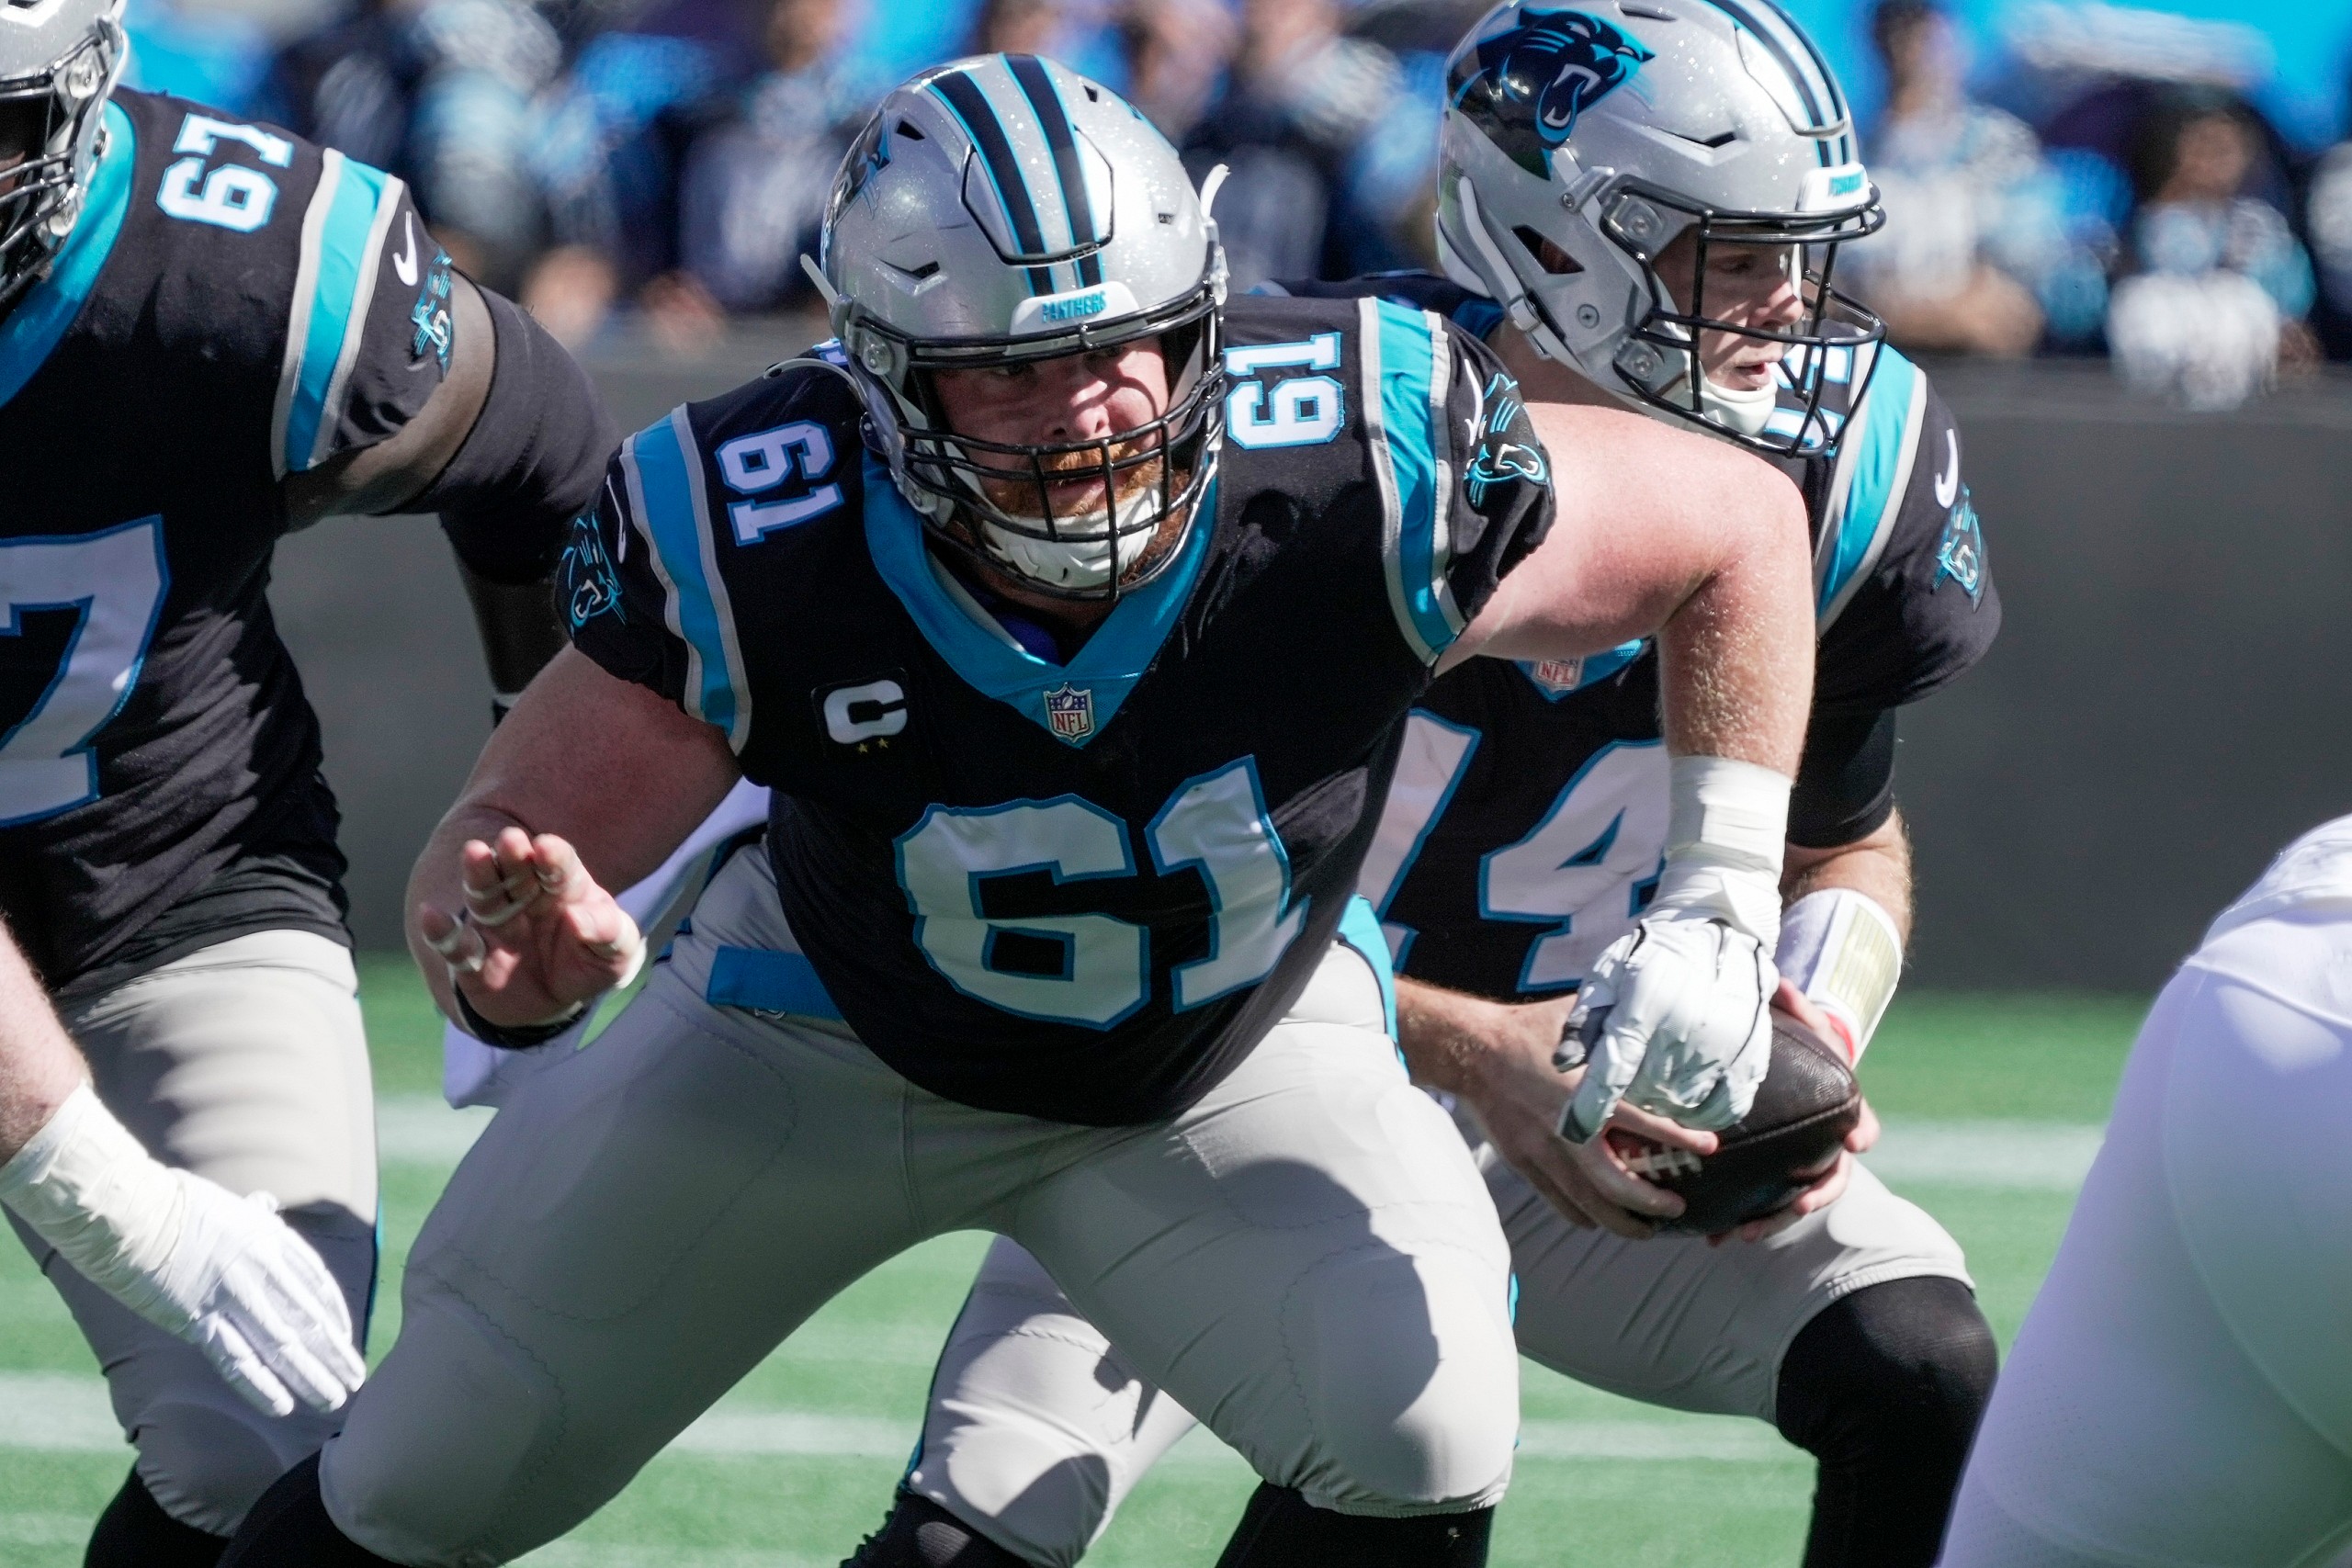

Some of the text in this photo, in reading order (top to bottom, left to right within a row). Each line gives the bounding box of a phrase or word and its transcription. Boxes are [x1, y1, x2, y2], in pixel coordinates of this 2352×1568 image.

[156, 112, 293, 233] 67
[1041, 291, 1106, 323] PANTHERS
[1224, 332, 1345, 450] 61
[715, 420, 843, 547] 61
[823, 680, 908, 744] C
[1054, 712, 1087, 733] NFL
[894, 754, 1311, 1031] 61
